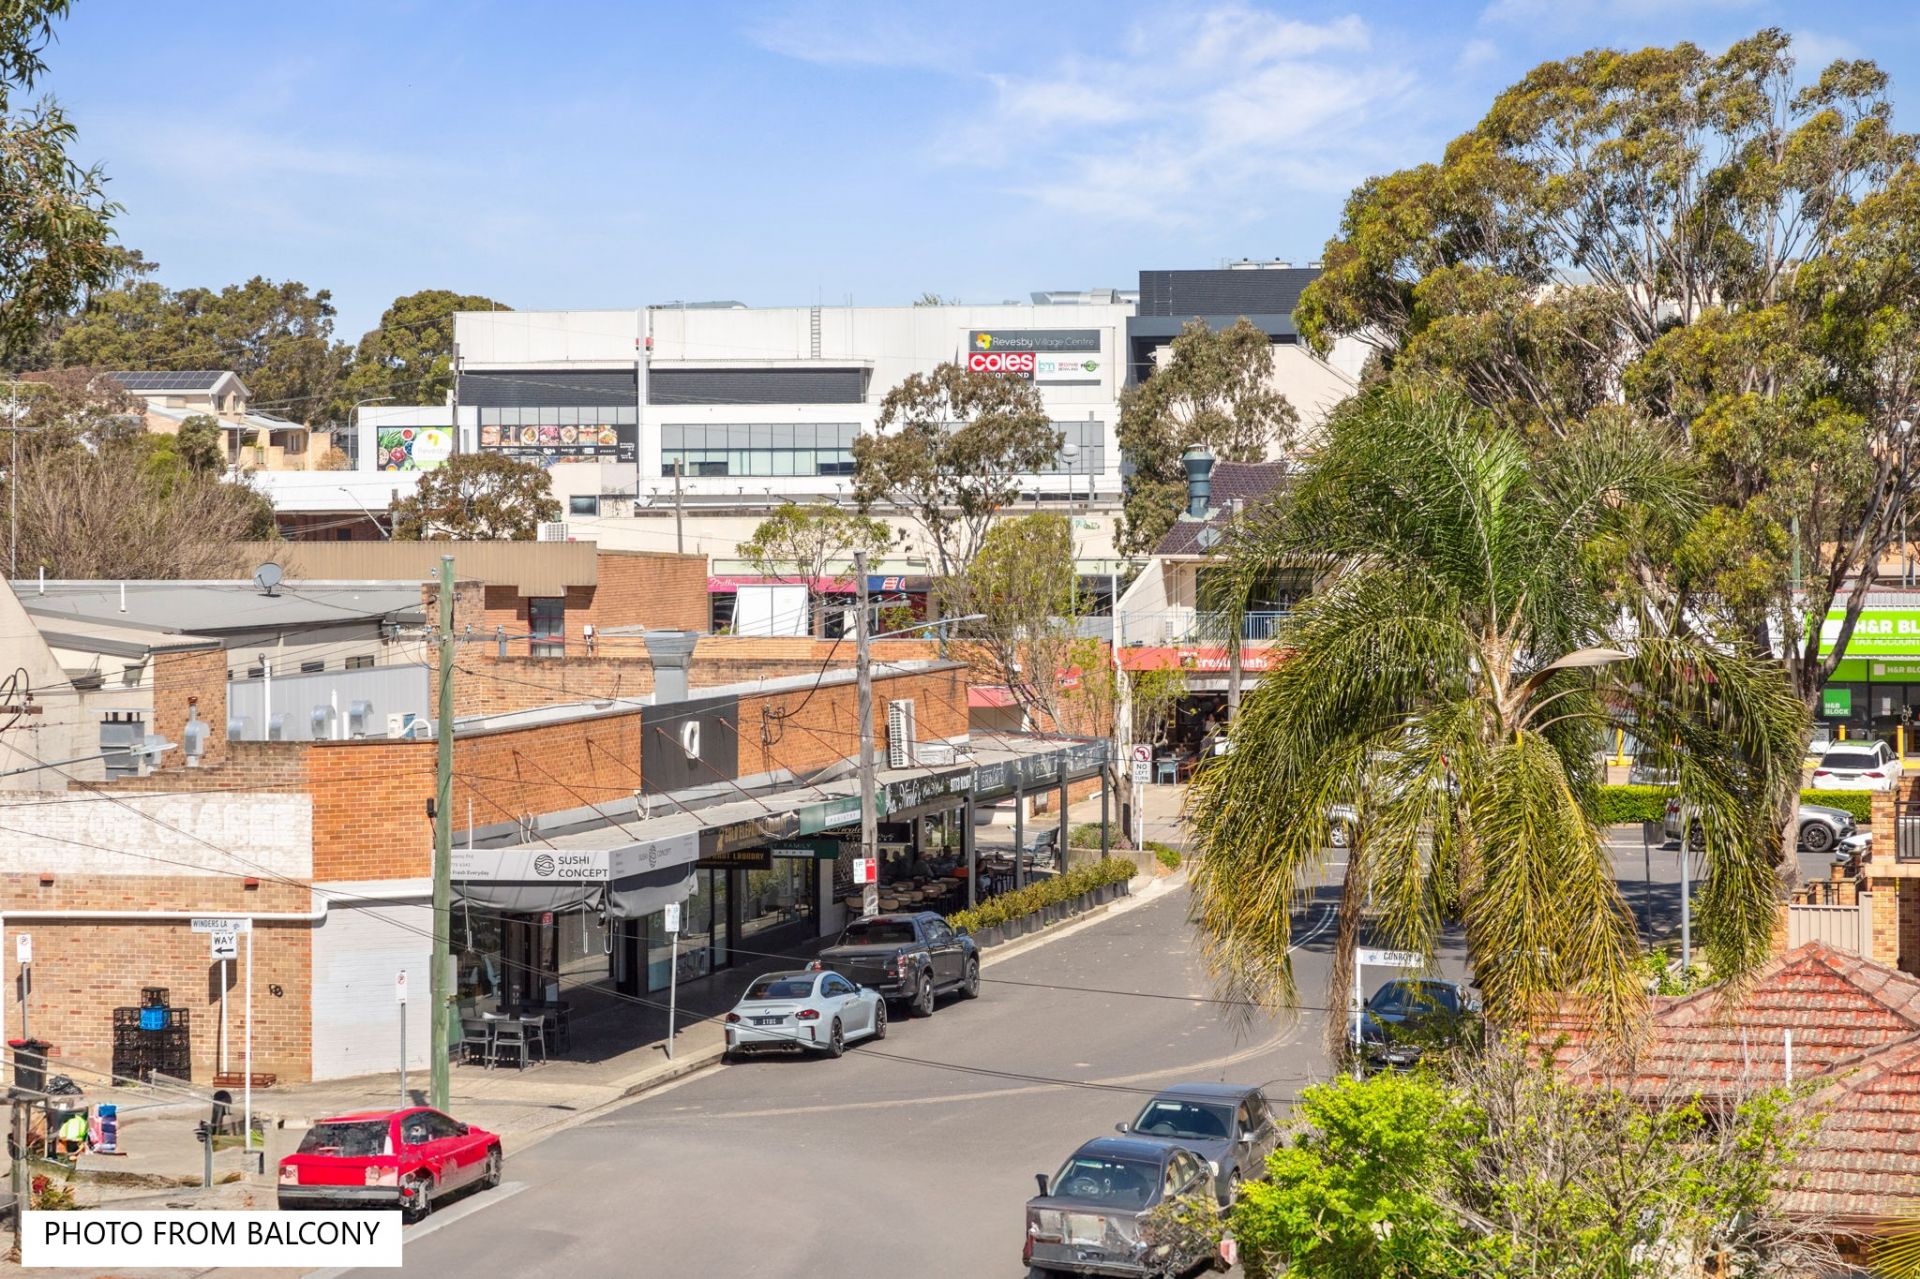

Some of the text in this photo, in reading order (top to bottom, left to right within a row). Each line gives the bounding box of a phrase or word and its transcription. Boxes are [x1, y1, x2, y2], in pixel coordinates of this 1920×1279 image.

[992, 337, 1095, 348] Revesby Village Centre
[970, 353, 1033, 371] coles
[1853, 619, 1893, 634] H&R
[558, 856, 590, 865] SUSHI
[558, 868, 608, 878] CONCEPT
[193, 920, 228, 928] WINDERS LA
[213, 936, 234, 945] WAY
